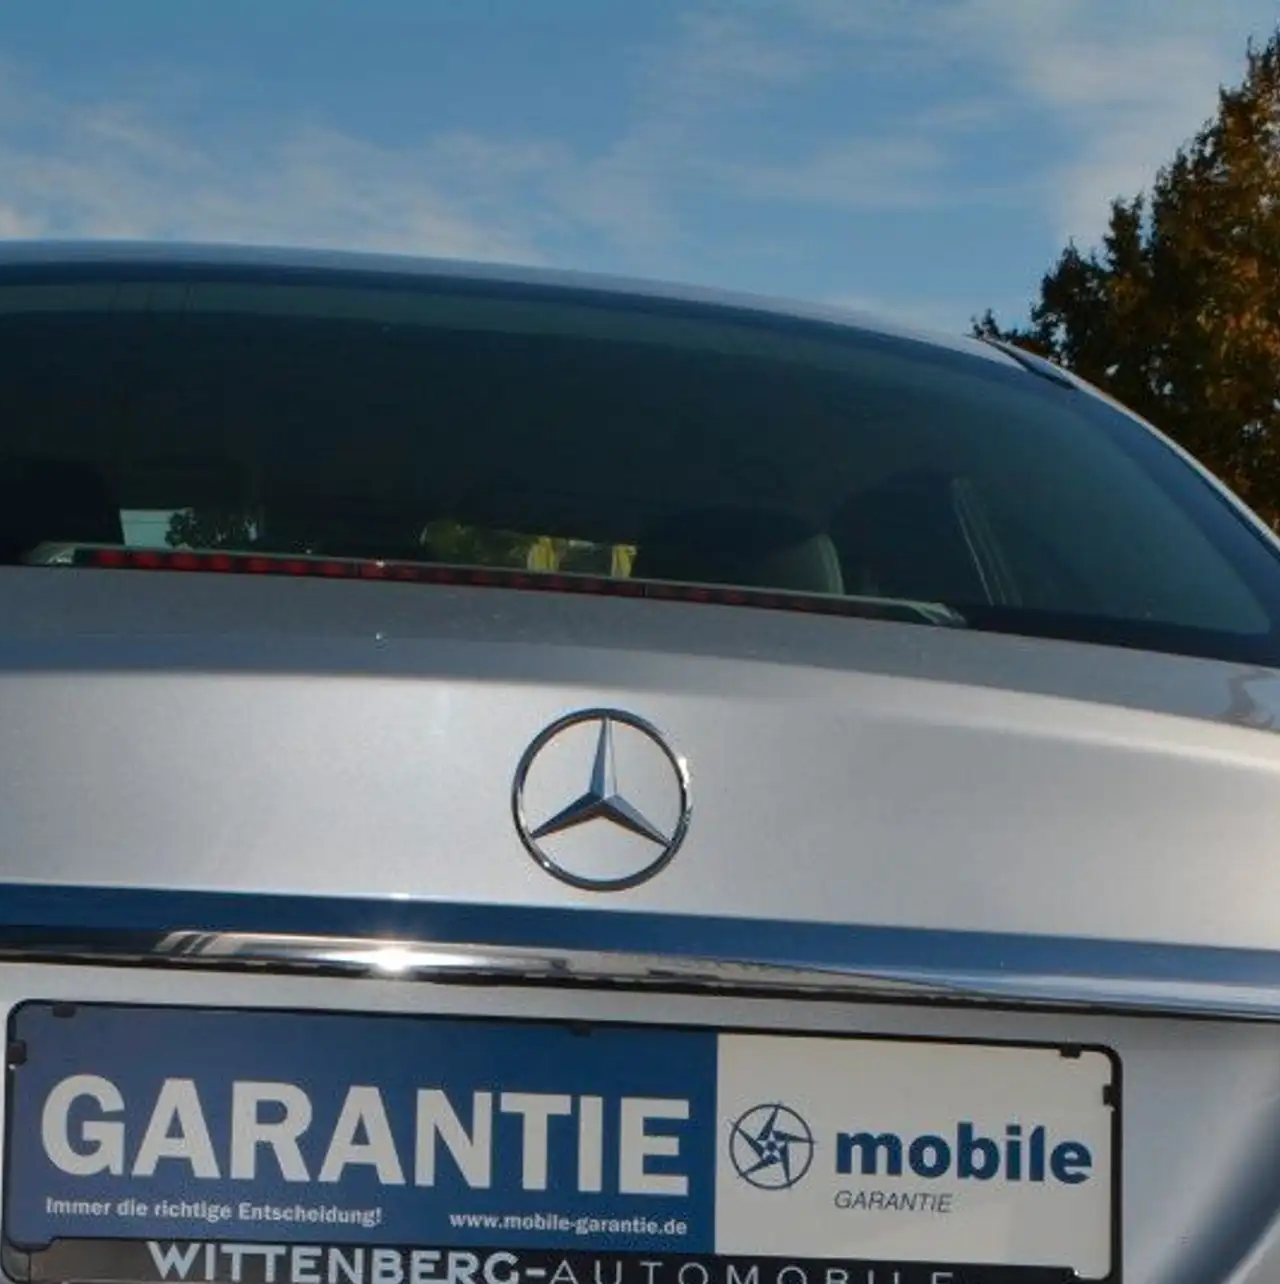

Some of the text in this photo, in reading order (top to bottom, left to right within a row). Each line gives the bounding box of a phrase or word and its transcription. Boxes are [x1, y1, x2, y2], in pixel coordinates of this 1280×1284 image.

[40, 1073, 691, 1197] GARANTIE
[834, 1121, 1094, 1185] mobile
[46, 1197, 383, 1228] Immer die richtige Entscheidung!
[833, 1190, 954, 1214] GARANTIE
[448, 1211, 688, 1236] www.mobile-garantie.de
